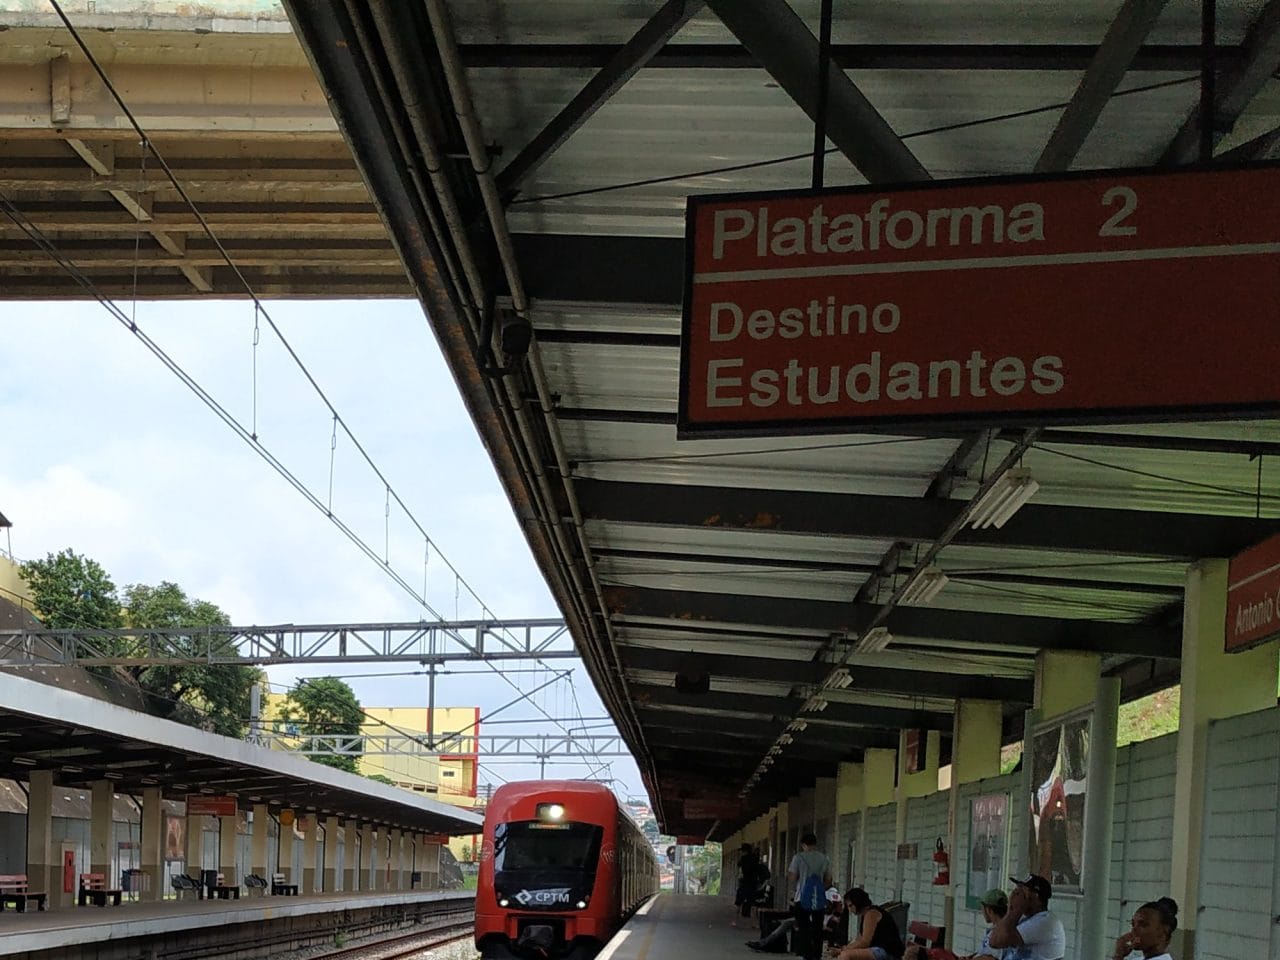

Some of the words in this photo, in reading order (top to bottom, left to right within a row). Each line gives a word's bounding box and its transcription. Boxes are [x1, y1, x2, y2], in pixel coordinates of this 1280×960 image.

[711, 199, 1046, 260] Plataforma
[1098, 185, 1139, 238] 2
[708, 296, 901, 343] Destino
[705, 350, 1065, 408] Estudantes
[1234, 591, 1273, 636] Antonio
[535, 892, 570, 903] CPTM
